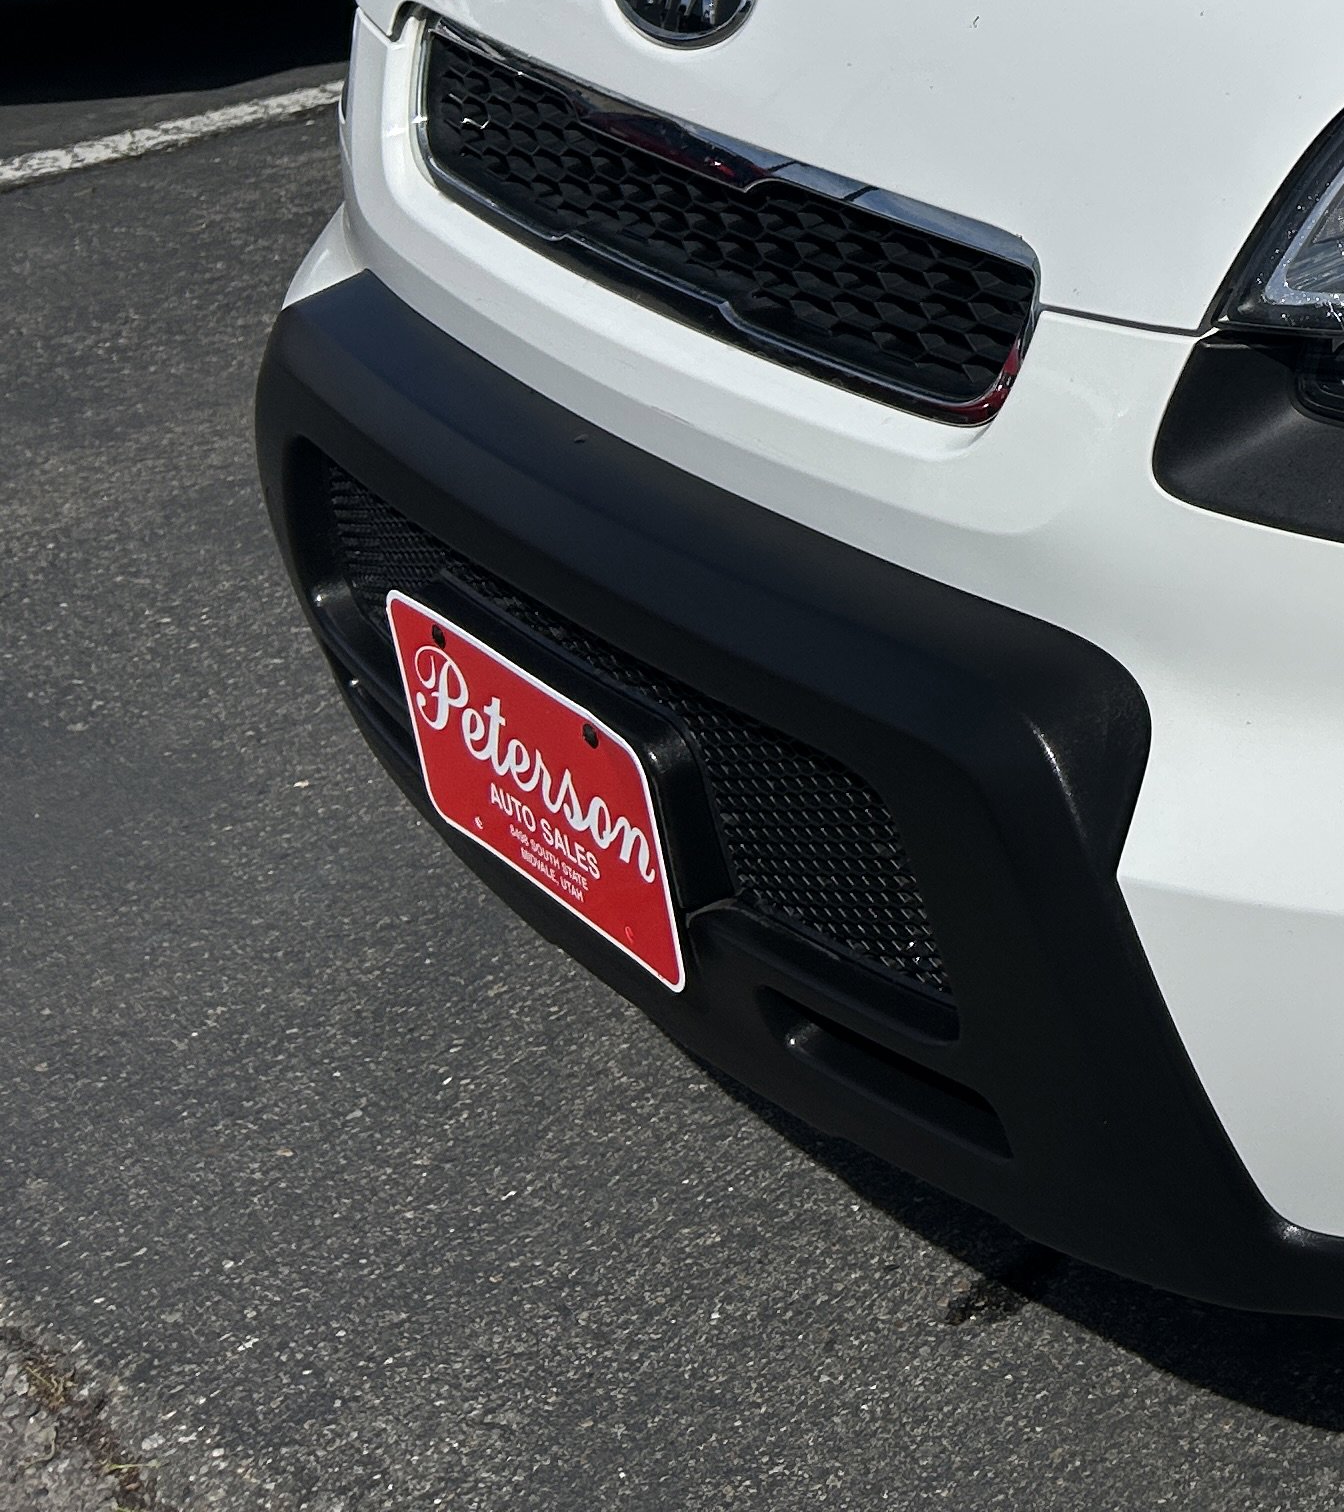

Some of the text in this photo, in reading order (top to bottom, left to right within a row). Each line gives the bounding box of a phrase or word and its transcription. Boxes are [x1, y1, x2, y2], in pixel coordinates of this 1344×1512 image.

[413, 644, 655, 883] Peterson
[490, 783, 536, 832] AUTO
[540, 818, 601, 880] SALES
[530, 838, 589, 891] SOUTH STATE
[560, 875, 584, 903] UTAH
